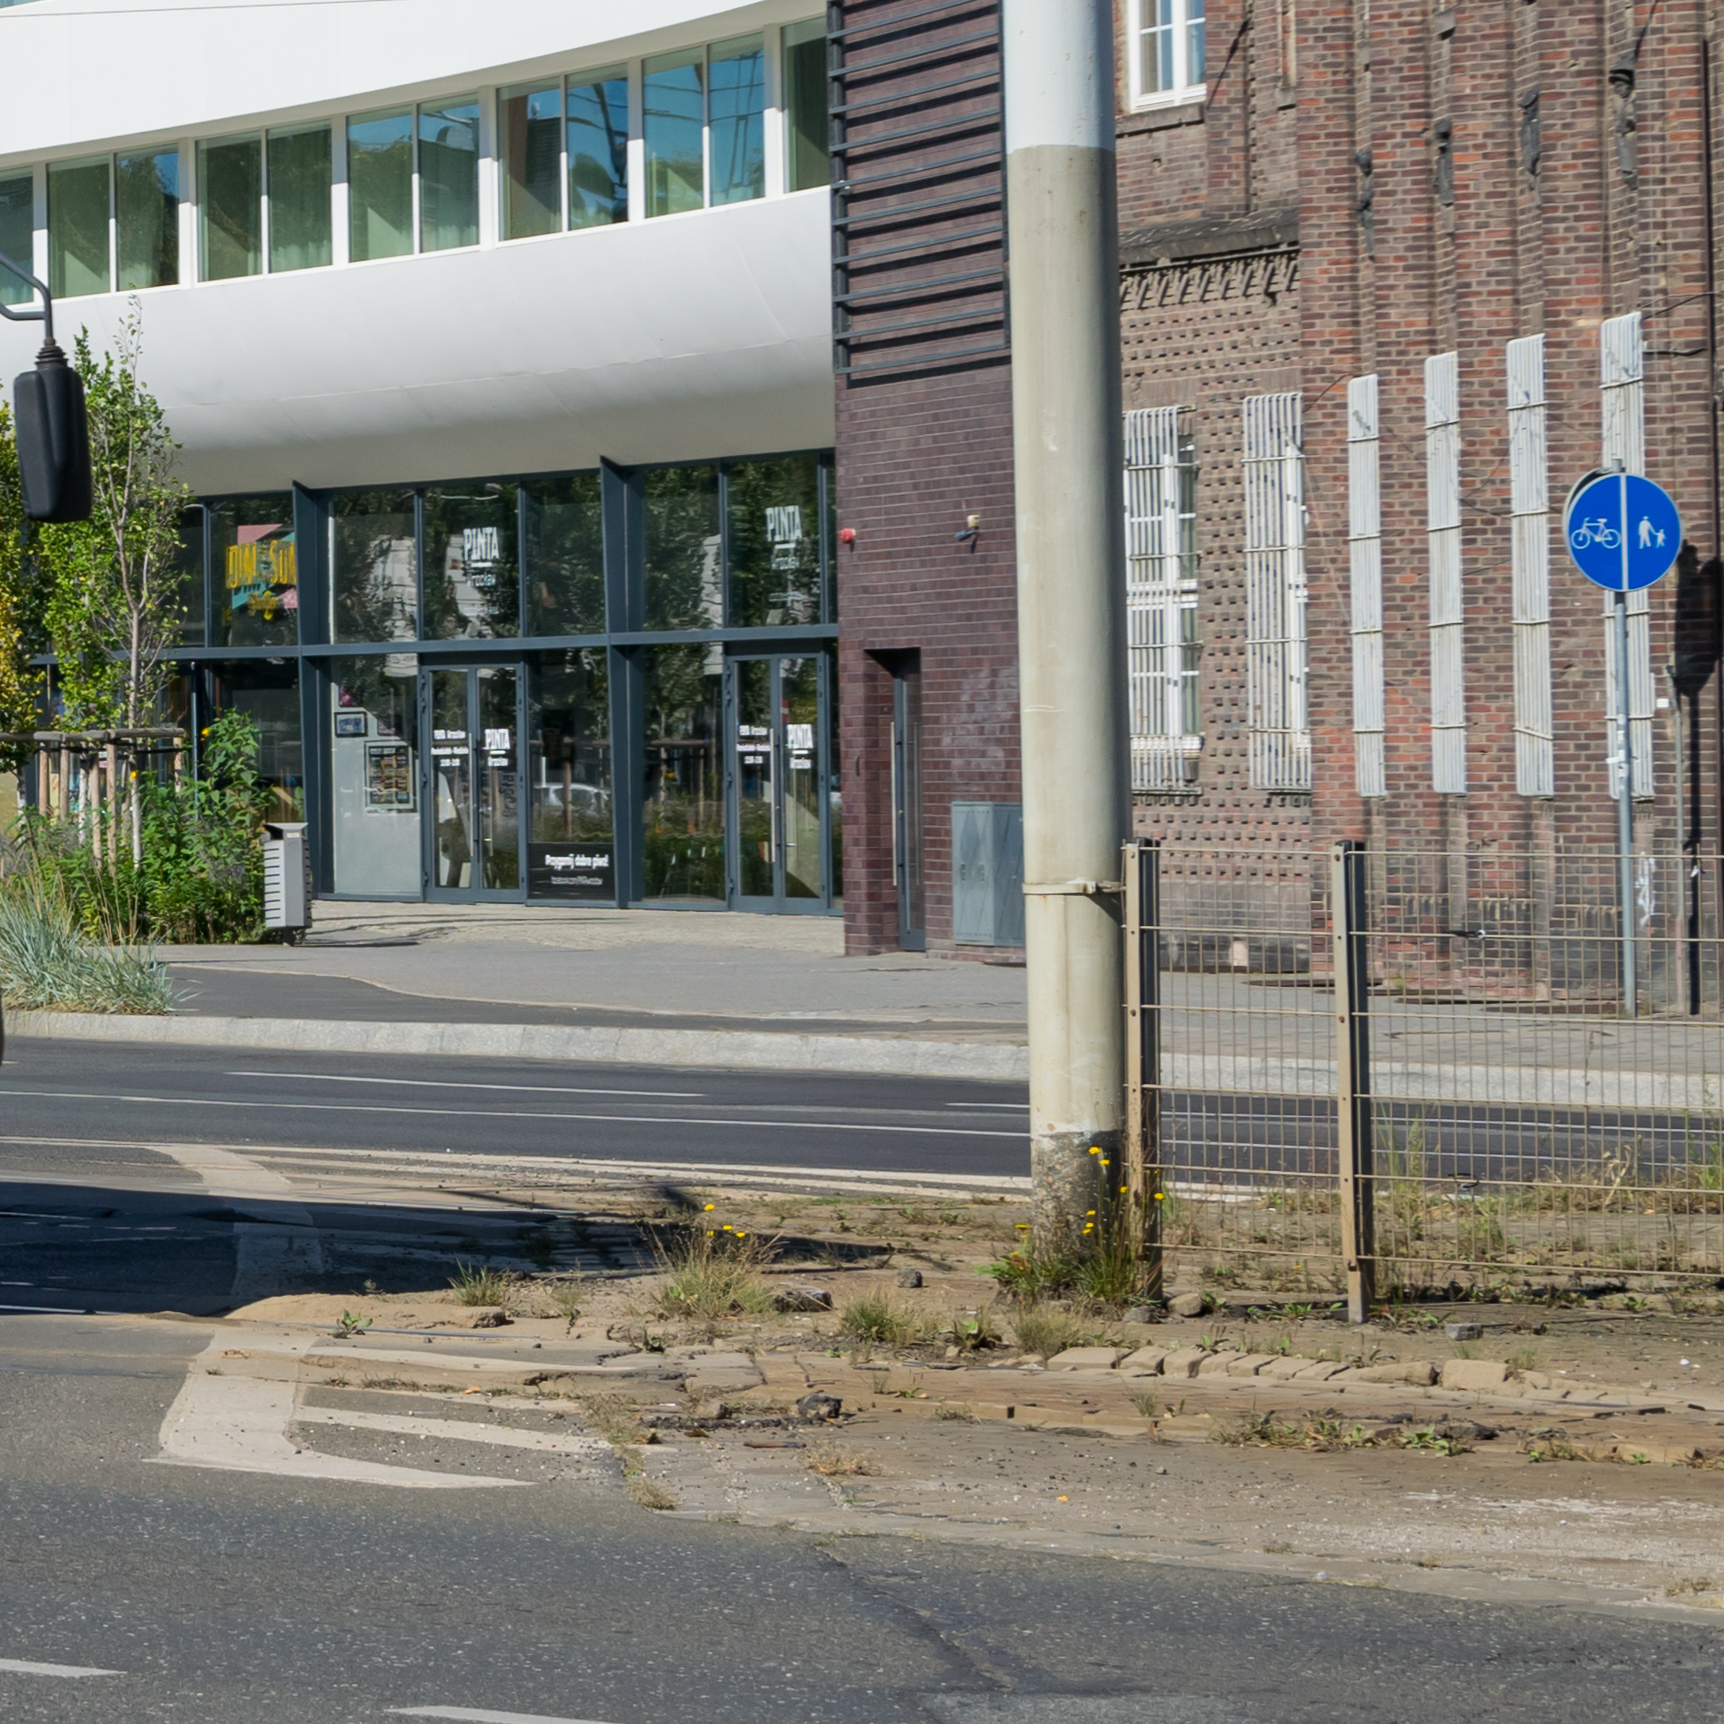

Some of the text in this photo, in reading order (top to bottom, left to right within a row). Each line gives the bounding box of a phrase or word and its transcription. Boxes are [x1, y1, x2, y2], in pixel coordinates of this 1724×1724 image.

[765, 505, 802, 542] PINTA
[463, 527, 500, 560] PINTA
[484, 728, 511, 749] PINTA
[786, 723, 814, 749] PINTA
